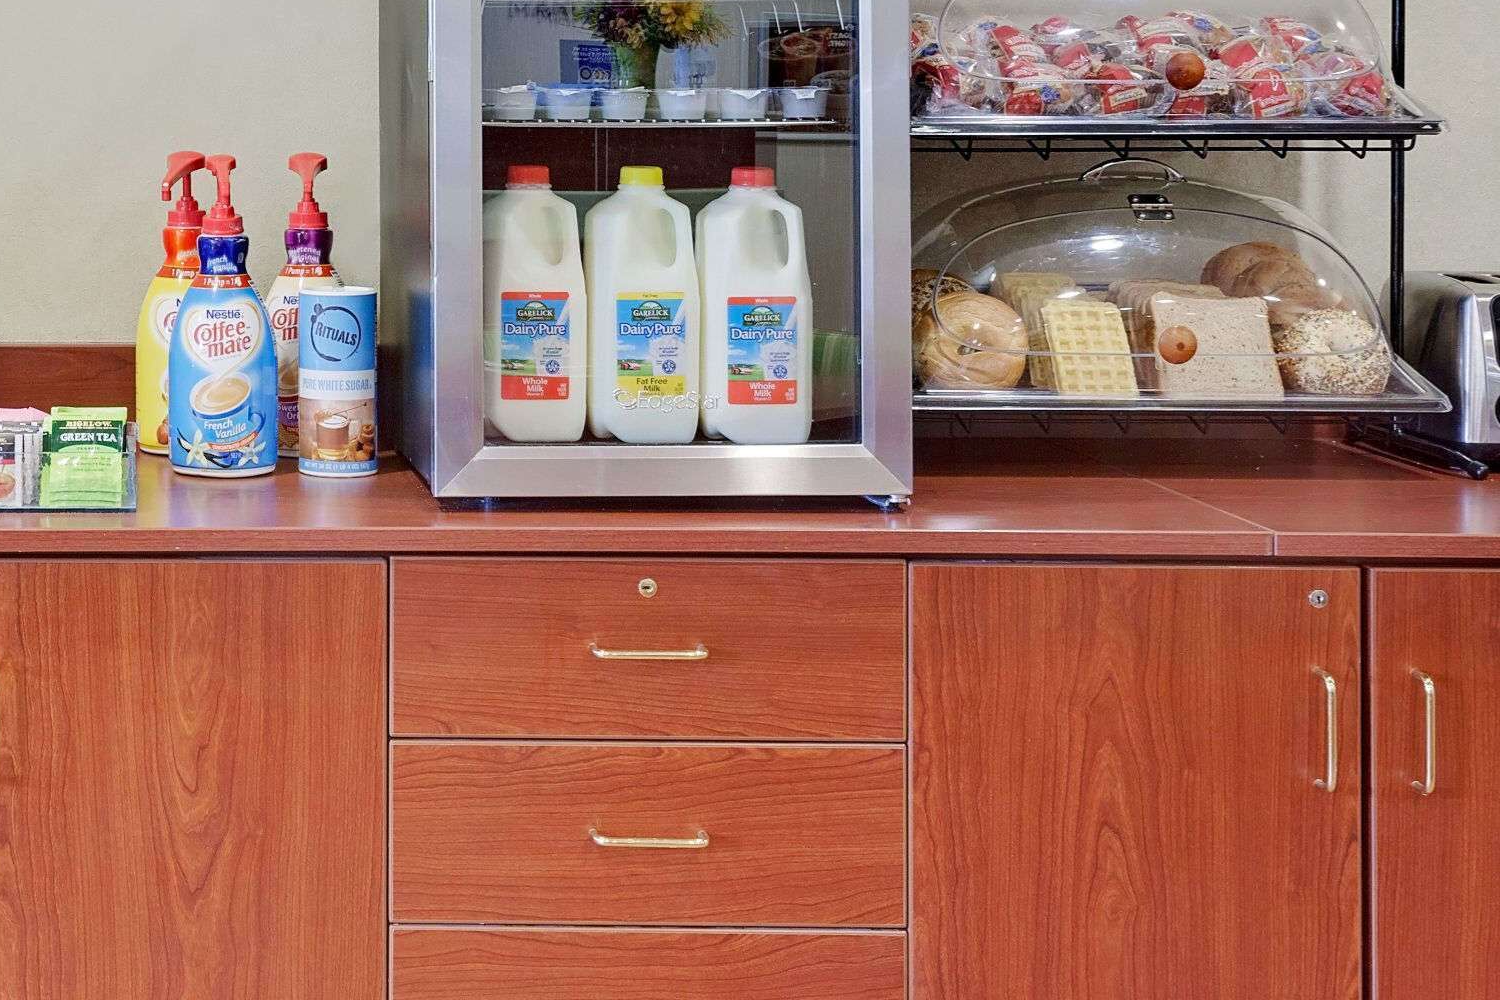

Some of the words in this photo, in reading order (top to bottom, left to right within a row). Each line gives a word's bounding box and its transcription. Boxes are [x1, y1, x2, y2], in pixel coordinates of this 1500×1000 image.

[517, 309, 554, 317] GARELICK
[632, 309, 669, 317] GARELICK
[743, 314, 780, 322] GARELICK
[315, 322, 358, 346] RITUALS
[205, 335, 252, 358] mate
[301, 377, 317, 390] PURE
[318, 378, 345, 391] WHITE
[521, 377, 548, 385] Whole
[636, 377, 649, 385] Fat
[650, 377, 669, 385] Free
[526, 384, 544, 392] Milk
[749, 382, 776, 390] Whole
[753, 389, 771, 397] Milk
[203, 418, 234, 430] French
[215, 423, 247, 439] Vanilla
[60, 432, 95, 442] GREEN
[96, 432, 117, 442] TEA
